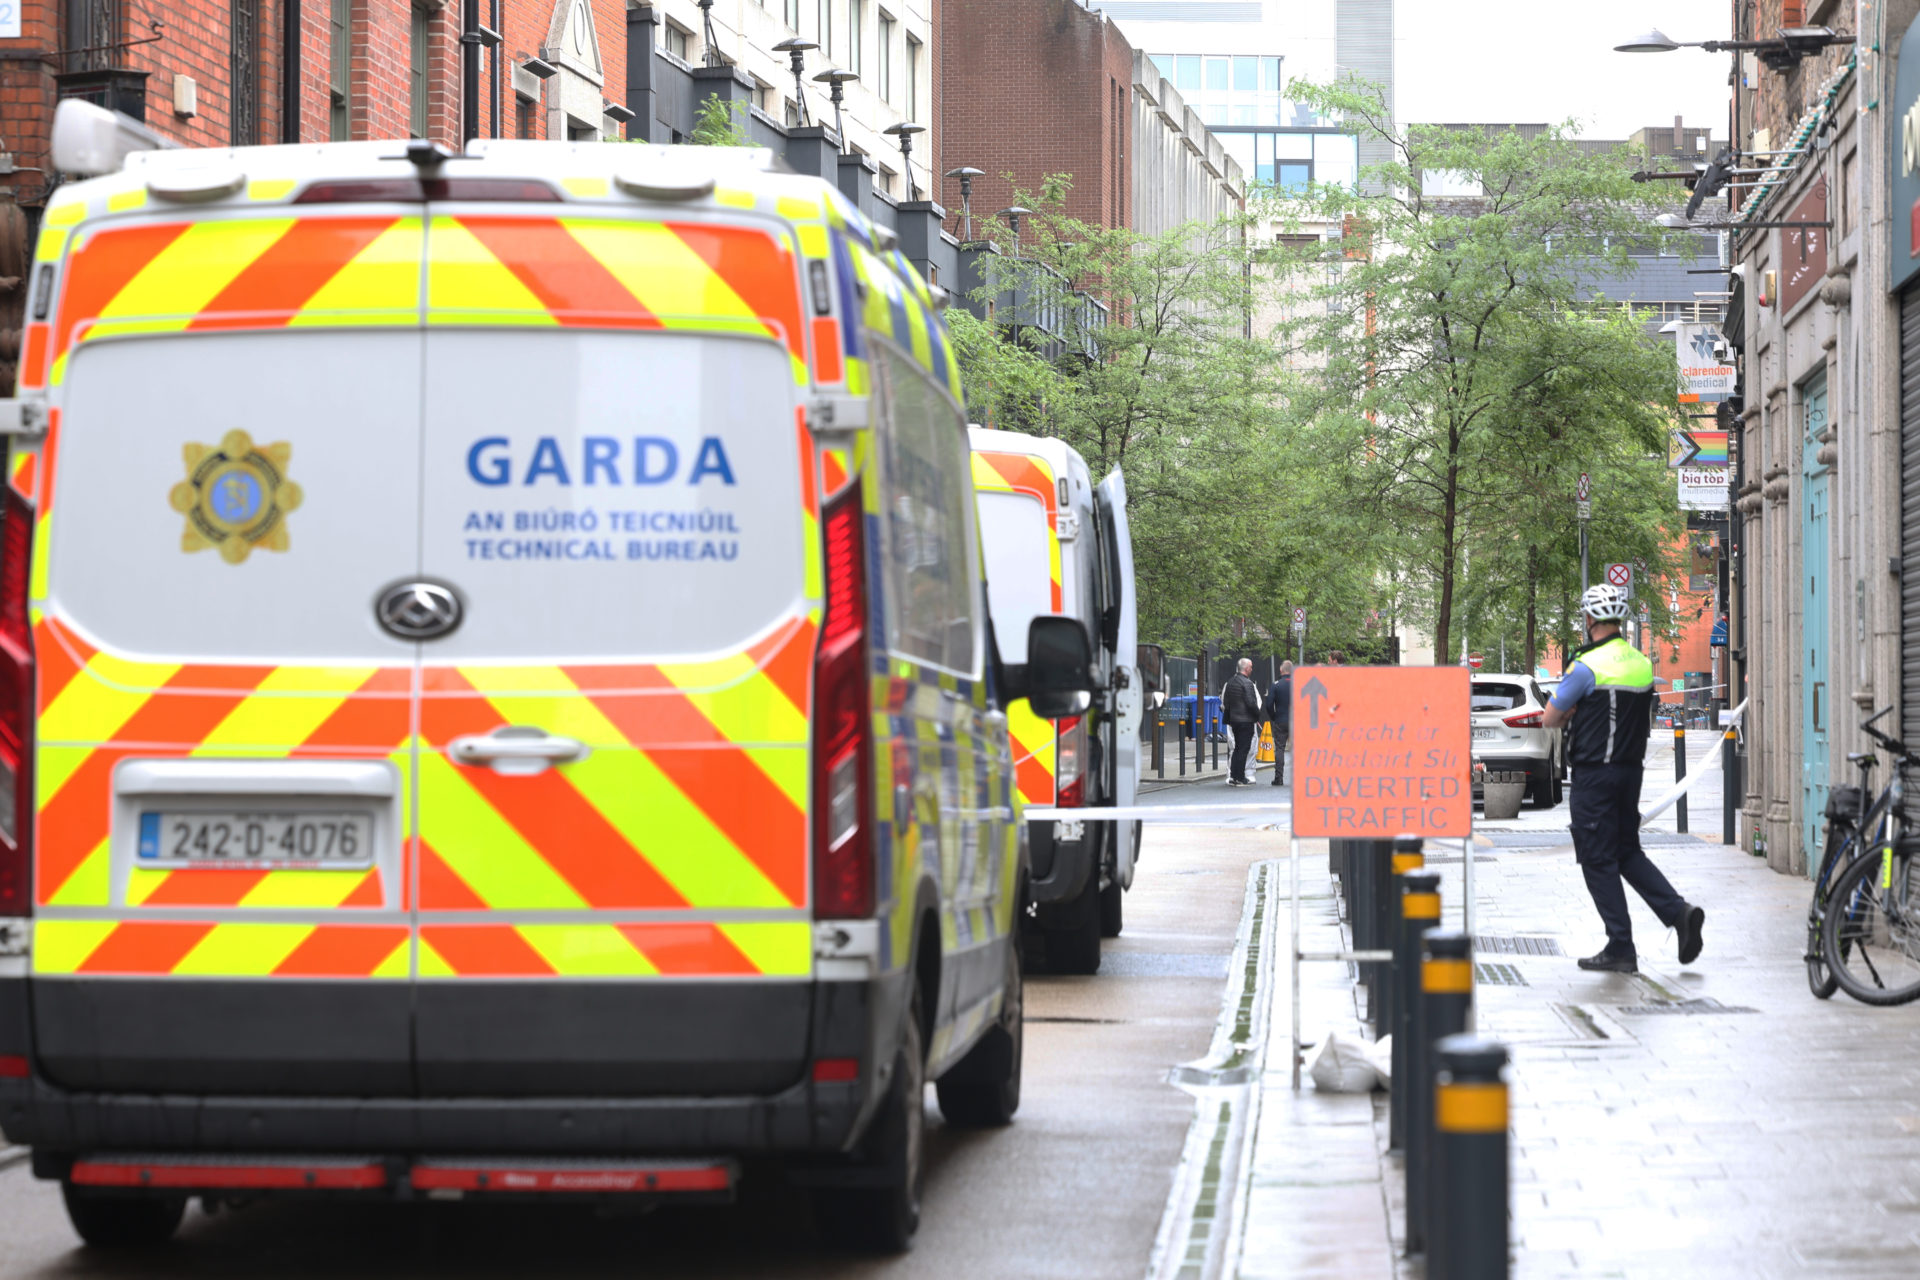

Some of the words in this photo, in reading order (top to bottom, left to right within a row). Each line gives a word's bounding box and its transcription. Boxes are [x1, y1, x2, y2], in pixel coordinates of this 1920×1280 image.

[1682, 365, 1733, 377] clarendon
[1688, 377, 1728, 388] medical
[466, 436, 737, 487] GARDA
[1704, 475, 1724, 484] top
[1682, 487, 1725, 495] multimedia
[464, 511, 504, 532] AN
[514, 507, 598, 532] BIÚRÓ
[609, 507, 740, 532] TEICNIÚIL
[465, 540, 617, 561] TECHNICAL
[627, 541, 739, 562] BUREAU
[1416, 727, 1440, 741] ar
[1306, 749, 1413, 769] Mhalairt
[1305, 776, 1459, 798] DIVERTED
[1318, 806, 1448, 829] TRAFFIC
[173, 822, 358, 858] 242-D-4076
